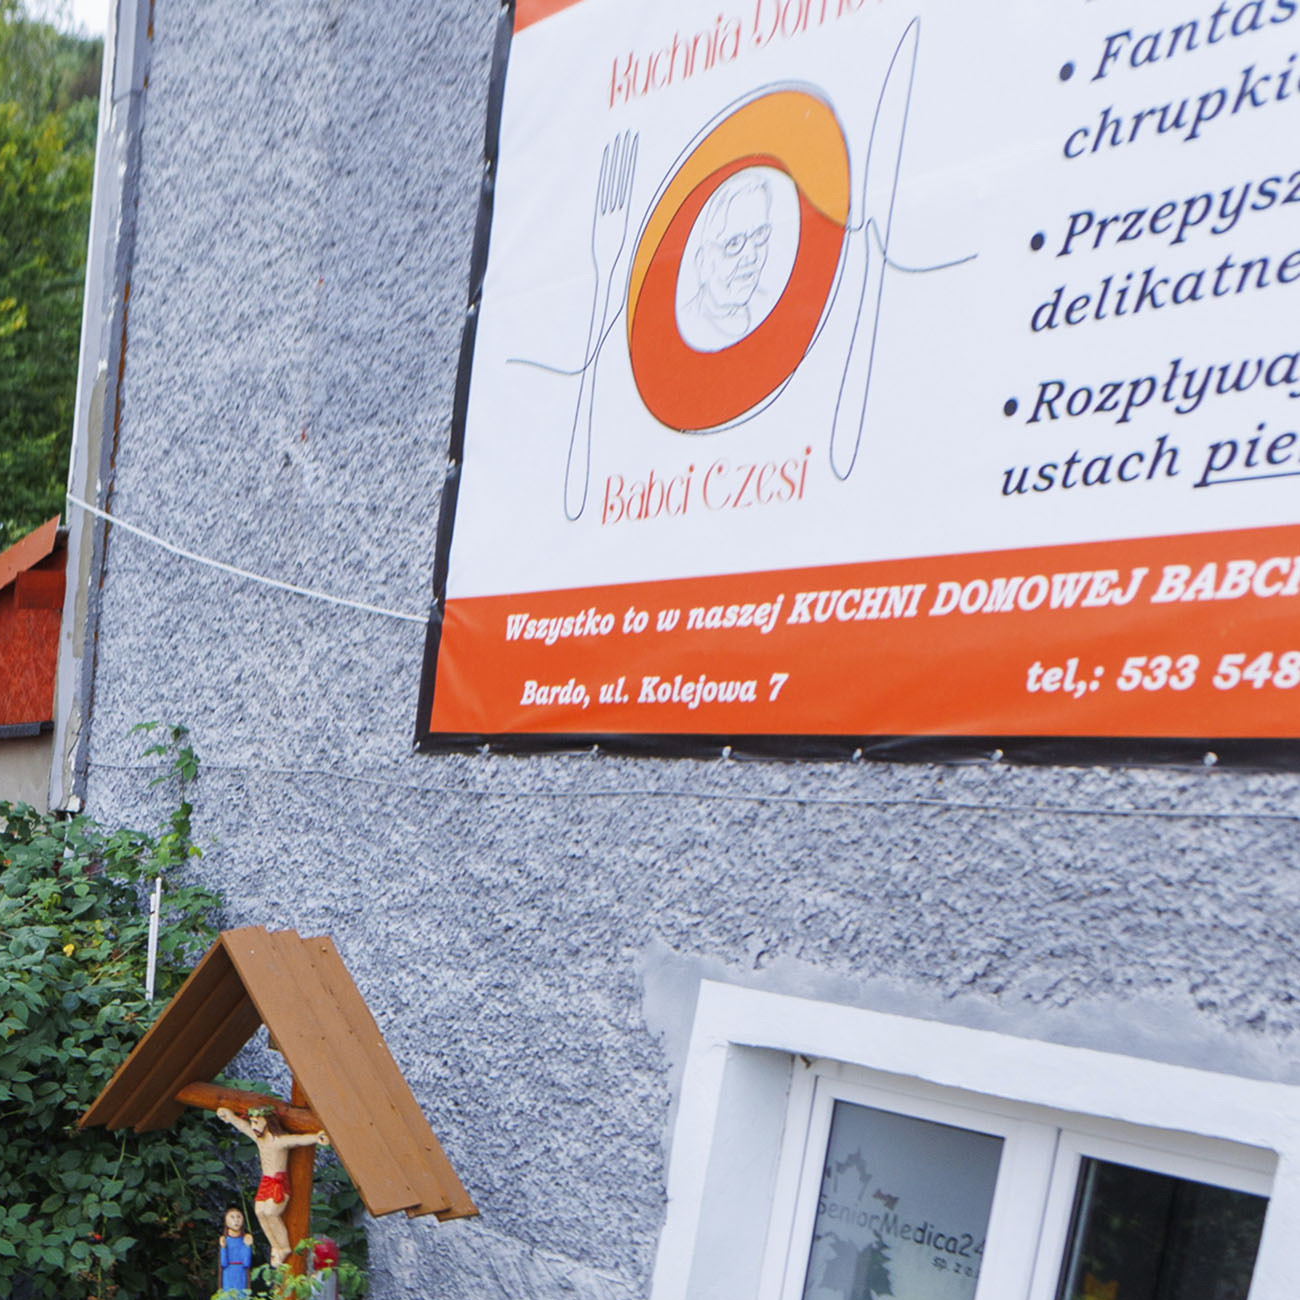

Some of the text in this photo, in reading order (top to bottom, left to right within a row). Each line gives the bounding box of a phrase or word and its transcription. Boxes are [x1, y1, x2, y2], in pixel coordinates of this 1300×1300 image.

[1063, 52, 1300, 158] chrupki
[1030, 249, 1300, 332] delikatne
[1025, 350, 1300, 424] Rozpływa
[602, 445, 811, 525] Babci Czesi
[1001, 421, 1300, 496] ustach pie
[505, 607, 615, 646] Wszystko
[622, 606, 649, 634] to
[656, 609, 680, 632] w
[686, 593, 784, 635] naszej
[787, 584, 927, 625] KUCHNI
[928, 567, 1149, 617] DOMOWEJ
[520, 672, 789, 710] Bardo, ul. Kolejowa 7
[1116, 654, 1200, 691] 533
[1212, 650, 1300, 690] 548
